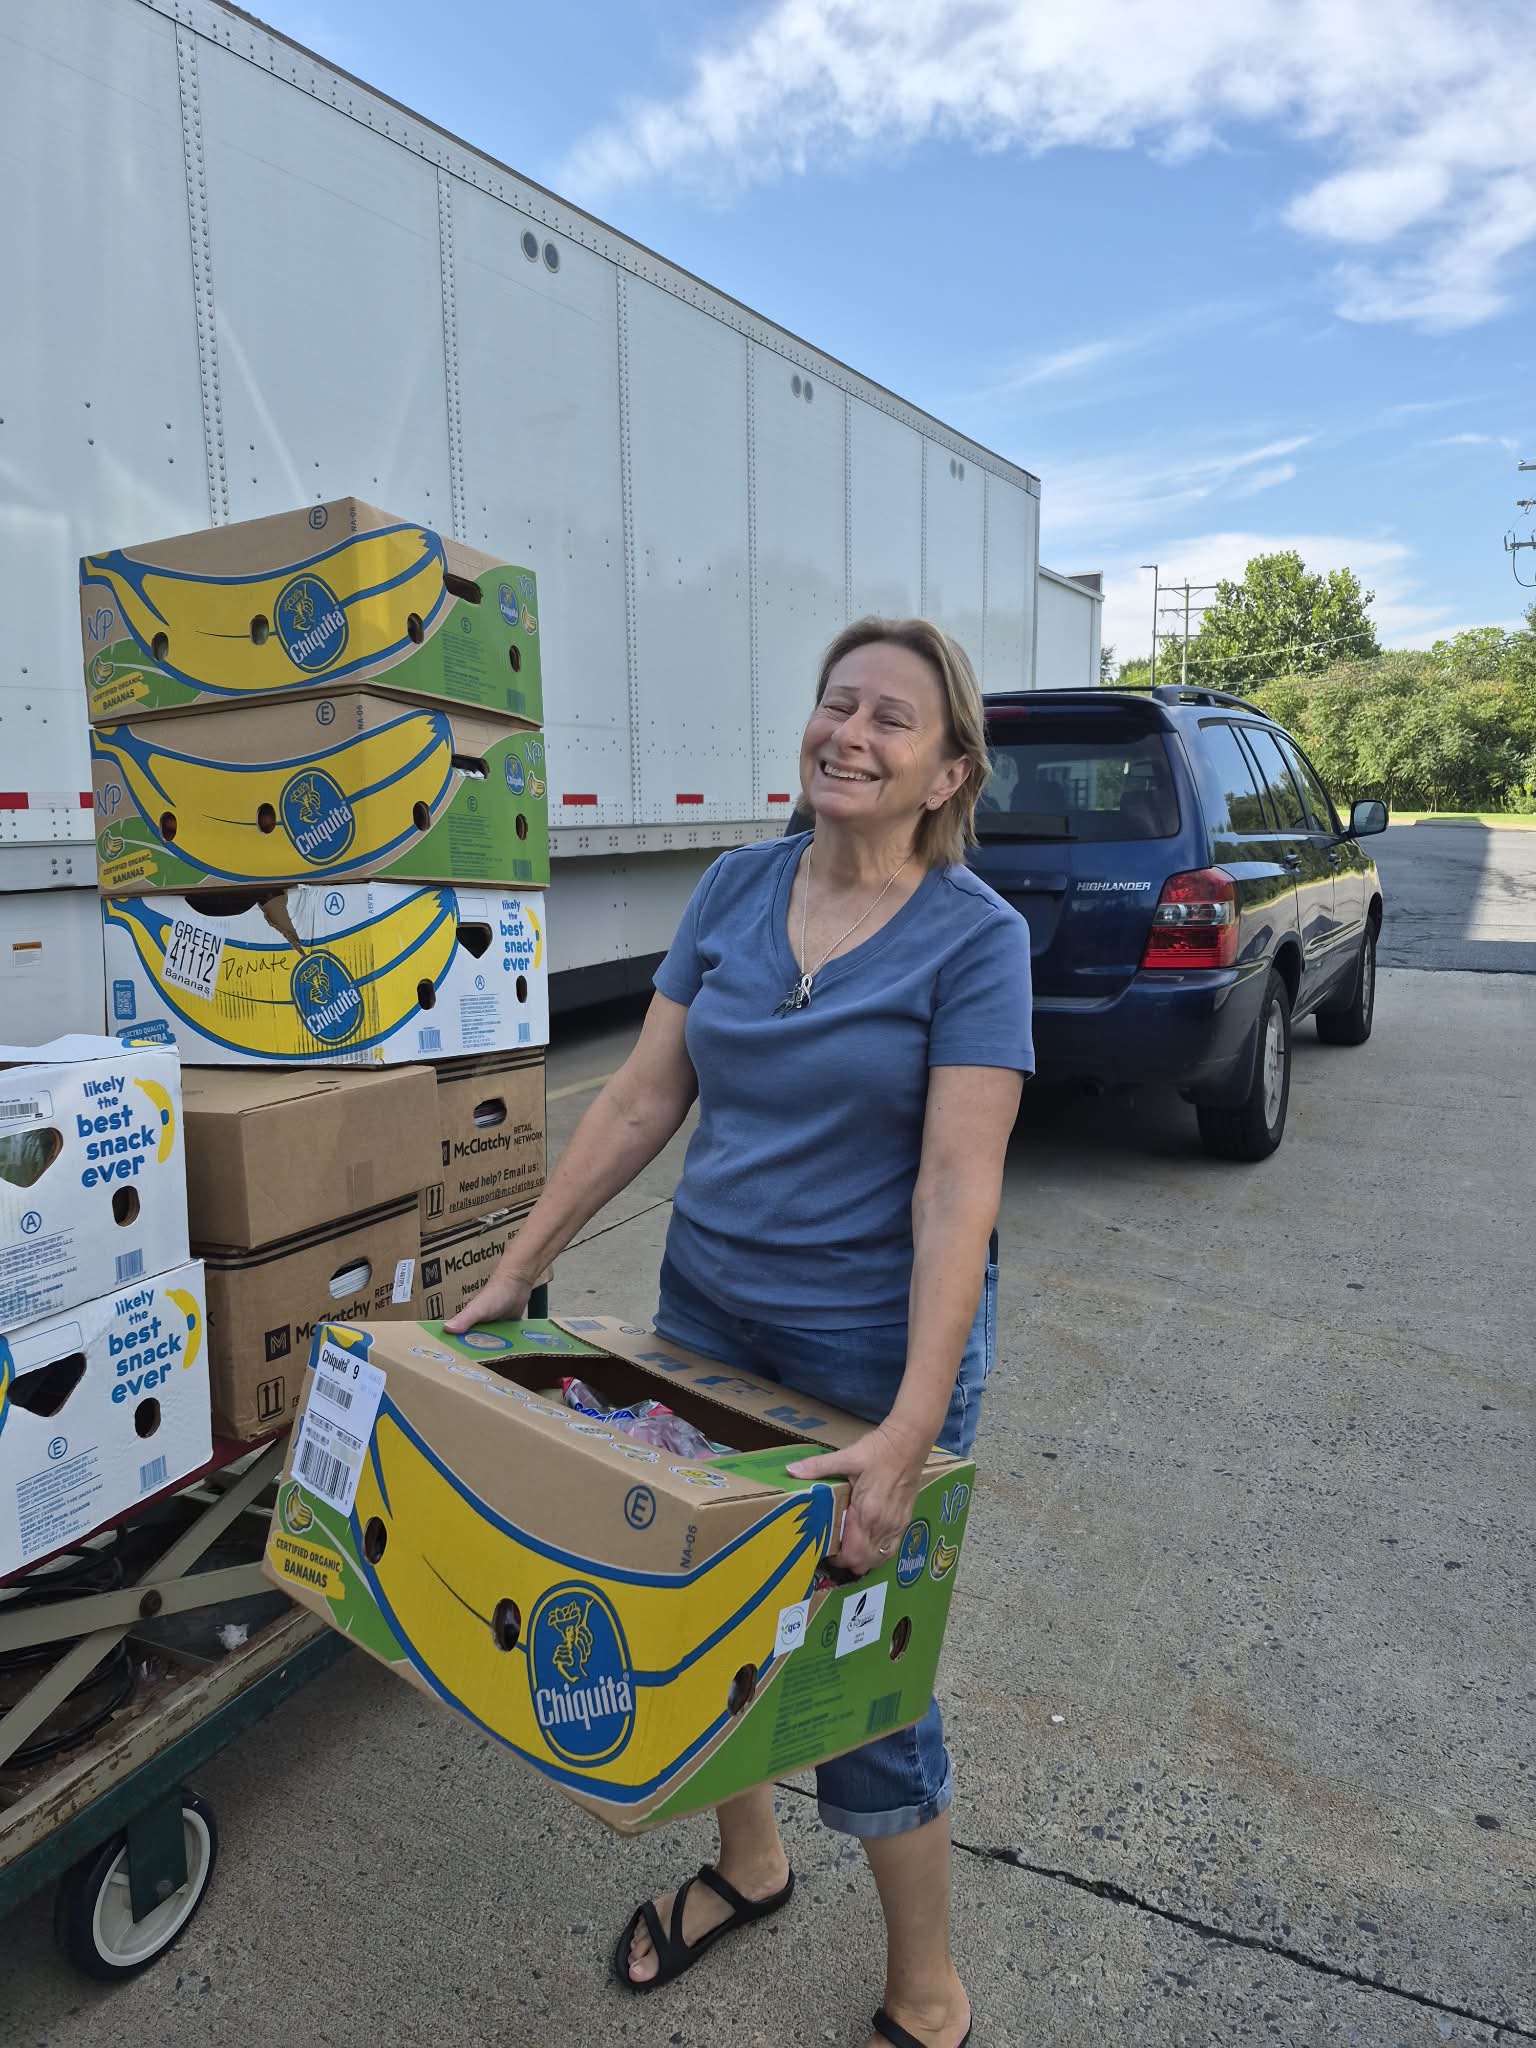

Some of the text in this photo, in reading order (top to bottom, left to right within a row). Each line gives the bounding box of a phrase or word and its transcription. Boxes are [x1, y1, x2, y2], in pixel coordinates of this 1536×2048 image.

[87, 607, 114, 641] NP
[289, 607, 345, 665] Chiquita
[102, 688, 135, 711] BANANAS
[95, 782, 122, 816] NP
[295, 801, 352, 858] Chiquita
[112, 866, 145, 887] BANANAS
[1076, 881, 1152, 892] HIGHLANDER
[502, 899, 521, 912] likely
[508, 912, 518, 920] the
[174, 920, 222, 955] GREEN
[500, 920, 524, 937] best
[169, 938, 216, 984] 41112
[504, 938, 534, 953] snack
[503, 956, 531, 971] ever
[165, 967, 211, 995] Bananas
[306, 985, 361, 1036] Chiquita
[83, 1075, 126, 1098] likely
[97, 1096, 119, 1110] the
[76, 1104, 133, 1138] best
[513, 1122, 533, 1135] RETAIL
[86, 1125, 156, 1160] snack
[454, 1130, 543, 1159] McClatchy NETWORK
[81, 1154, 145, 1188] ever
[459, 1162, 540, 1193] Need help? Email us:
[444, 1241, 505, 1275] McClatchy
[115, 1288, 155, 1317] likely
[461, 1279, 480, 1296] Need
[128, 1308, 149, 1326] the
[108, 1316, 162, 1356] best
[116, 1334, 183, 1377] snack
[110, 1360, 172, 1405] ever
[352, 1364, 360, 1380] 9
[938, 1481, 970, 1526] NP
[275, 1538, 341, 1573] CERTIFIED ORGANIC
[679, 1525, 698, 1569] NA-06
[283, 1561, 329, 1589] BANANAS
[535, 1678, 633, 1731] Chiquita
